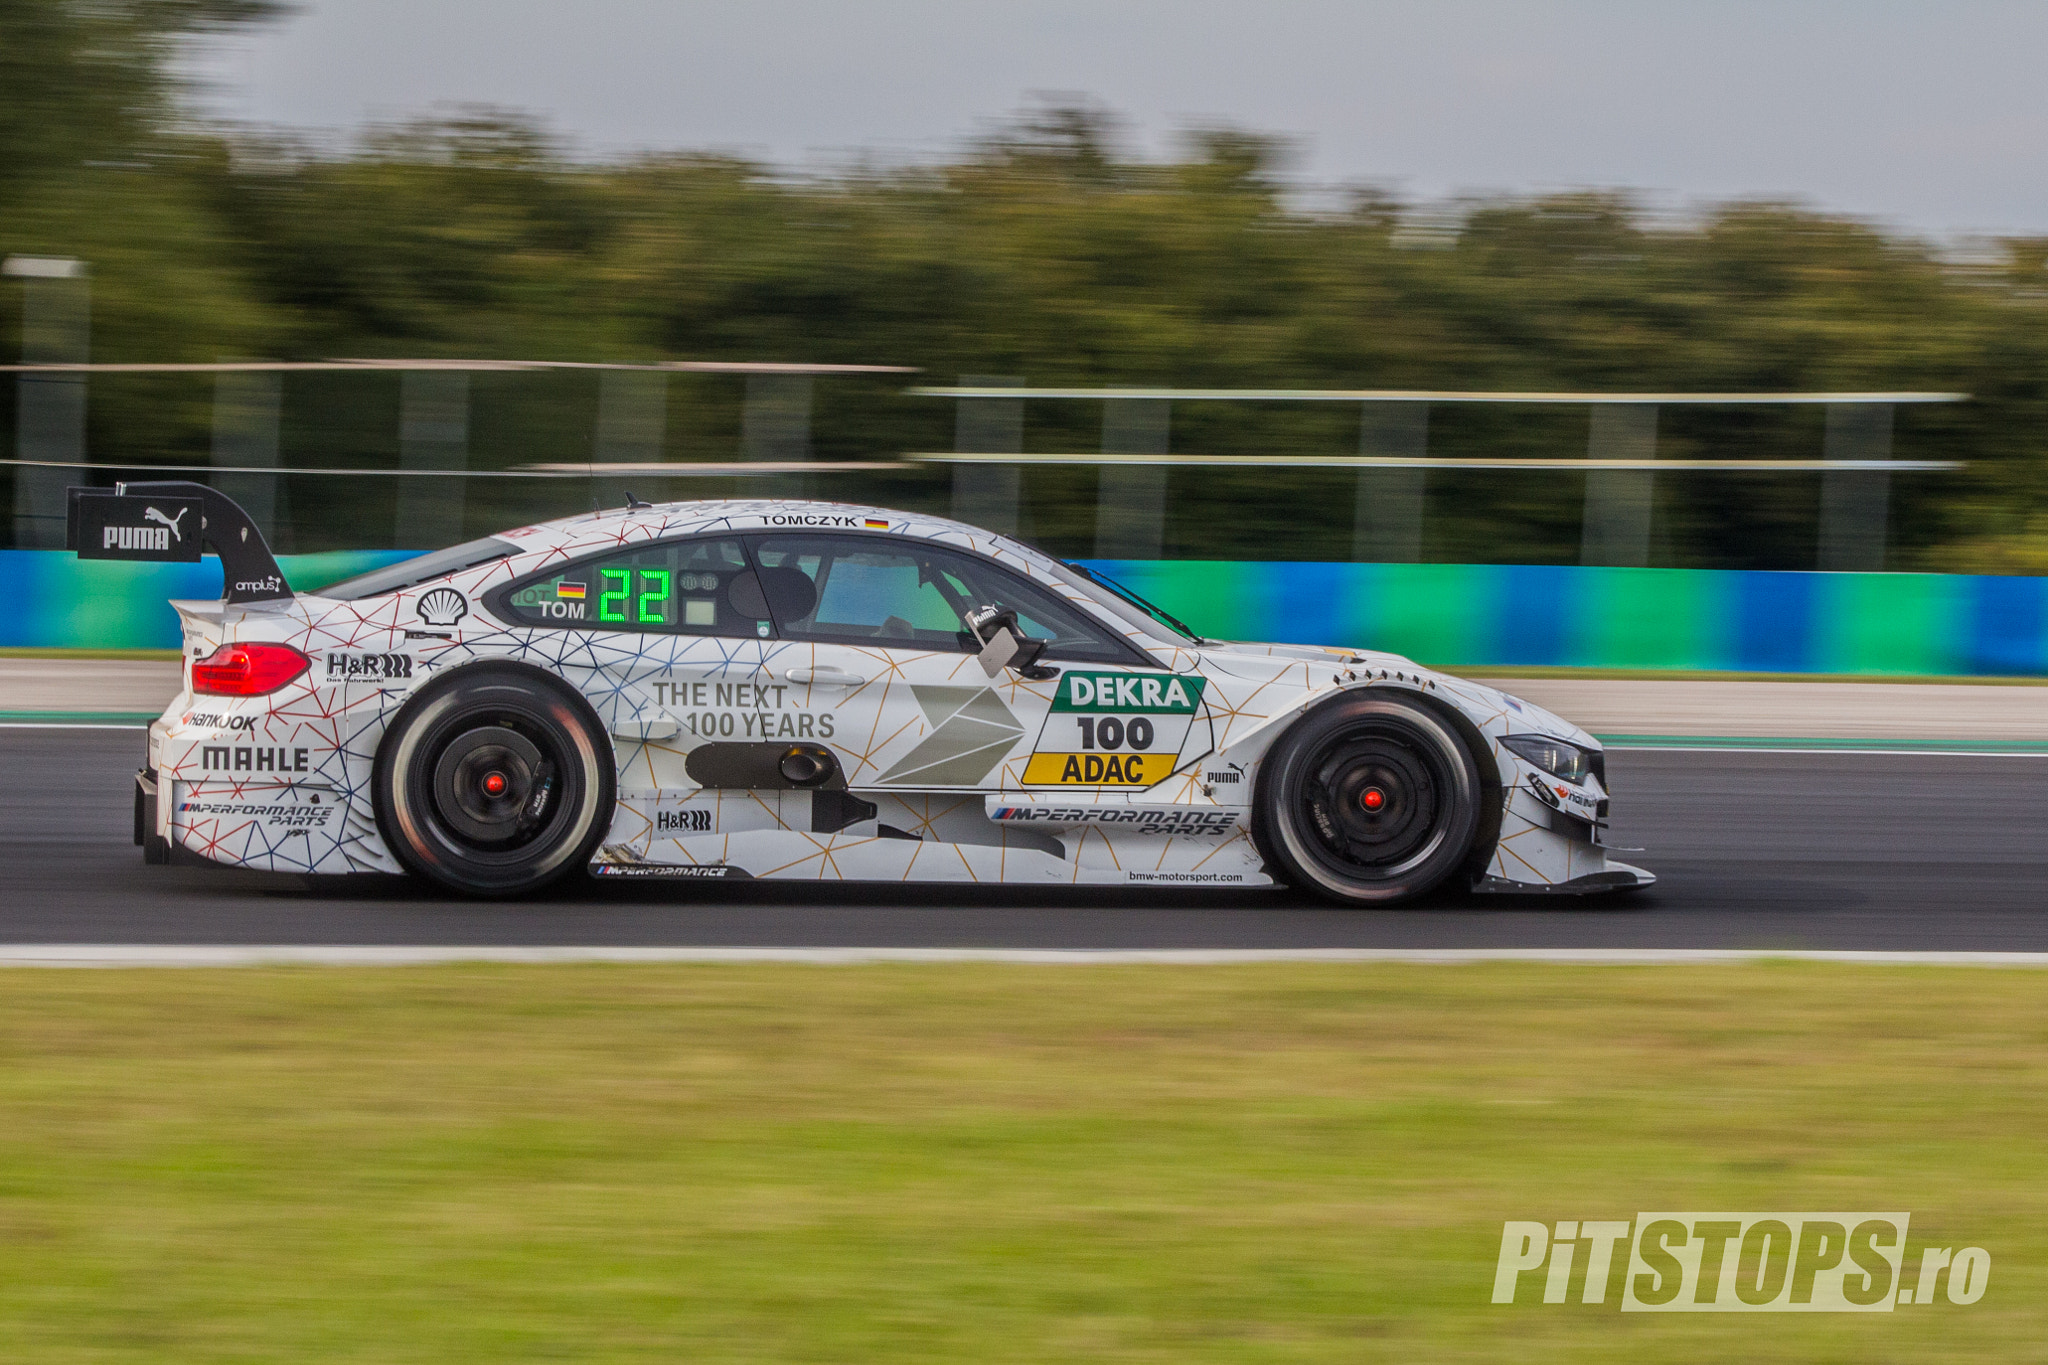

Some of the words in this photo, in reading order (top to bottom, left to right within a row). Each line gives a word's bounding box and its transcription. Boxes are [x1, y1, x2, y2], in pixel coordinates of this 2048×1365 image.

[759, 515, 858, 528] TOMCZYK
[103, 526, 169, 550] PUMA
[600, 568, 671, 623] 22
[538, 601, 585, 619] TOM
[972, 609, 997, 626] PUMA
[328, 653, 381, 676] H&R
[652, 682, 708, 706] THE
[715, 682, 788, 709] NEXT
[1069, 676, 1191, 708] DEKRA
[686, 712, 735, 737] 100
[741, 712, 835, 738] YEARS
[1077, 717, 1154, 751] 100
[202, 745, 309, 772] MAHLE
[1060, 755, 1144, 784] ADAC
[1207, 772, 1240, 784] PUMA
[268, 816, 329, 827] PARTS
[657, 810, 691, 832] H&R
[1138, 823, 1230, 836] PARTS
[1129, 871, 1243, 884] bmw-motorsport.com
